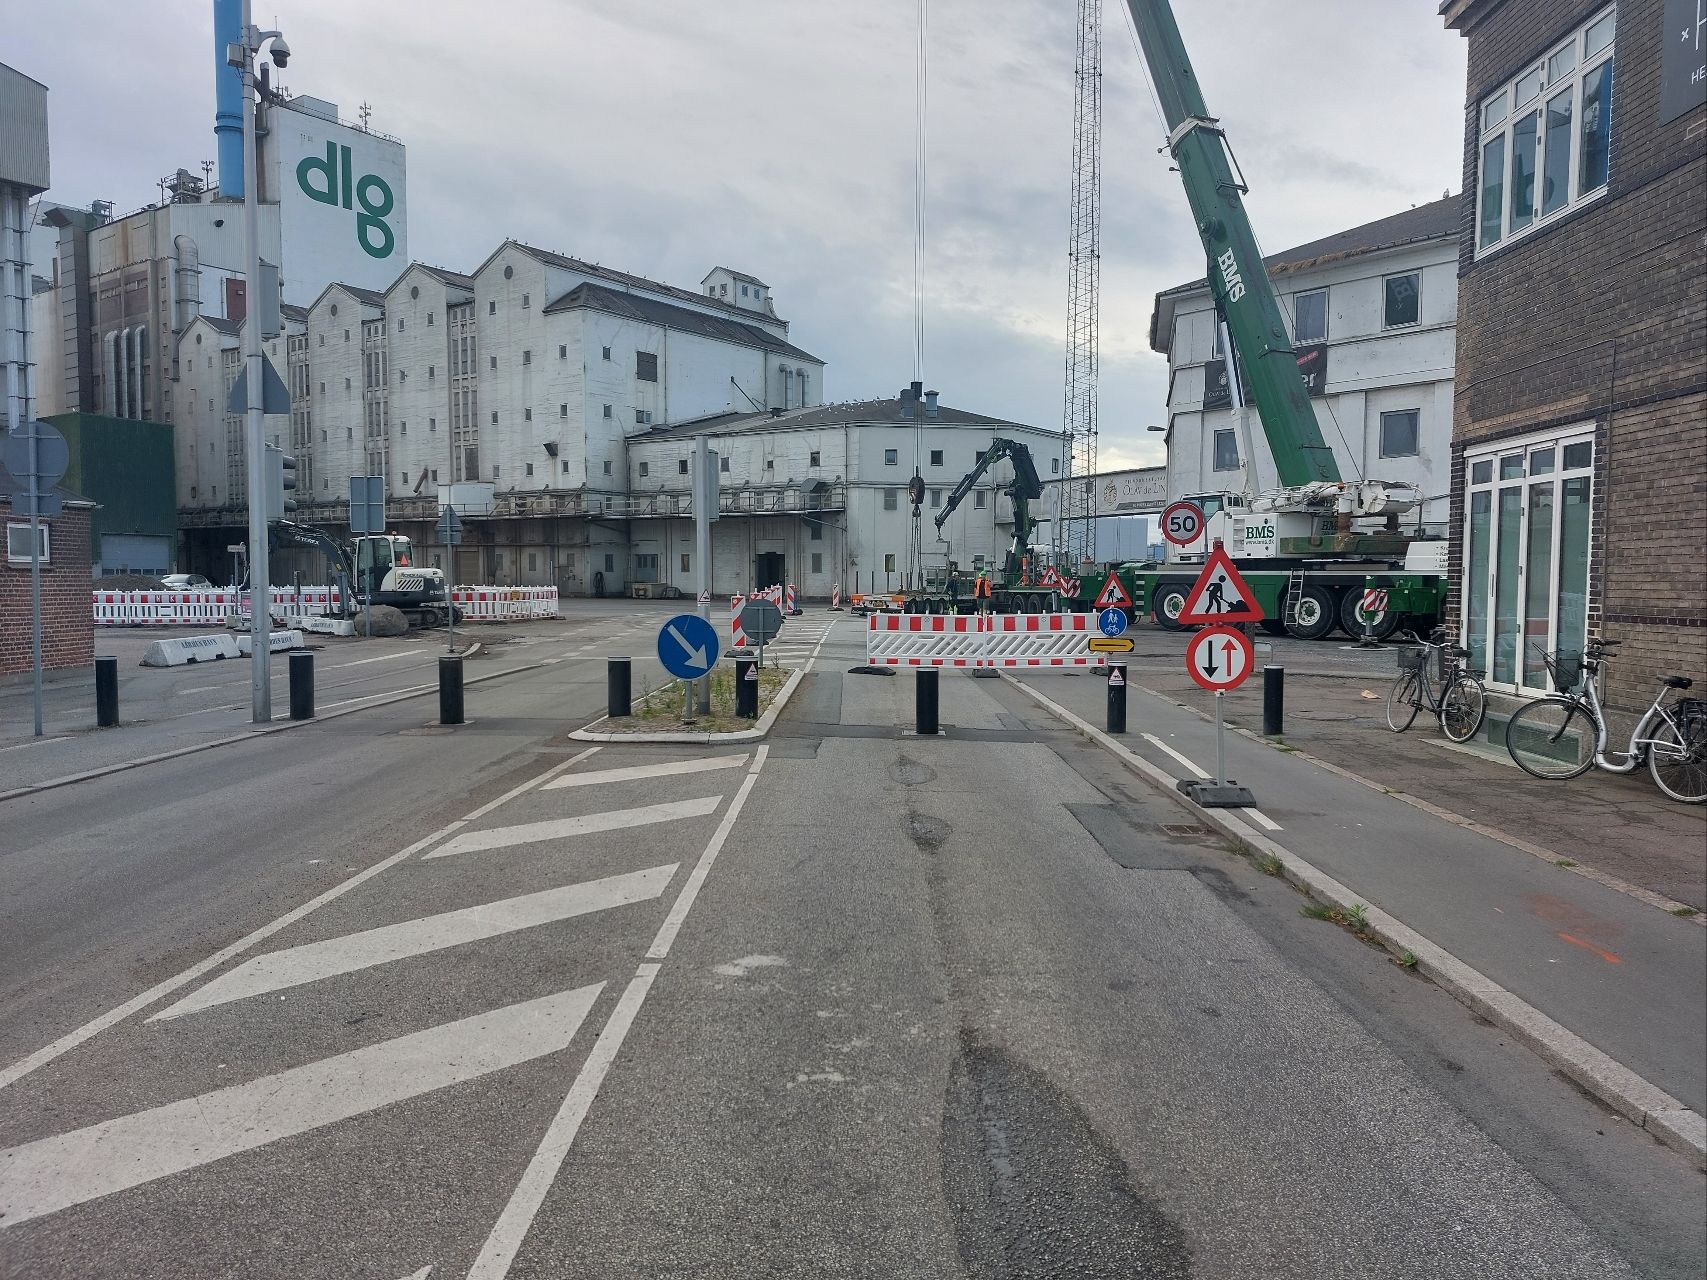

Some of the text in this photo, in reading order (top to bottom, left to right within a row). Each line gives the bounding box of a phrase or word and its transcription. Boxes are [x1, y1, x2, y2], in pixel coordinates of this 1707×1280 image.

[296, 139, 395, 259] dlg
[1217, 246, 1246, 303] BMS
[1169, 516, 1196, 533] 50
[1245, 525, 1275, 540] BMS
